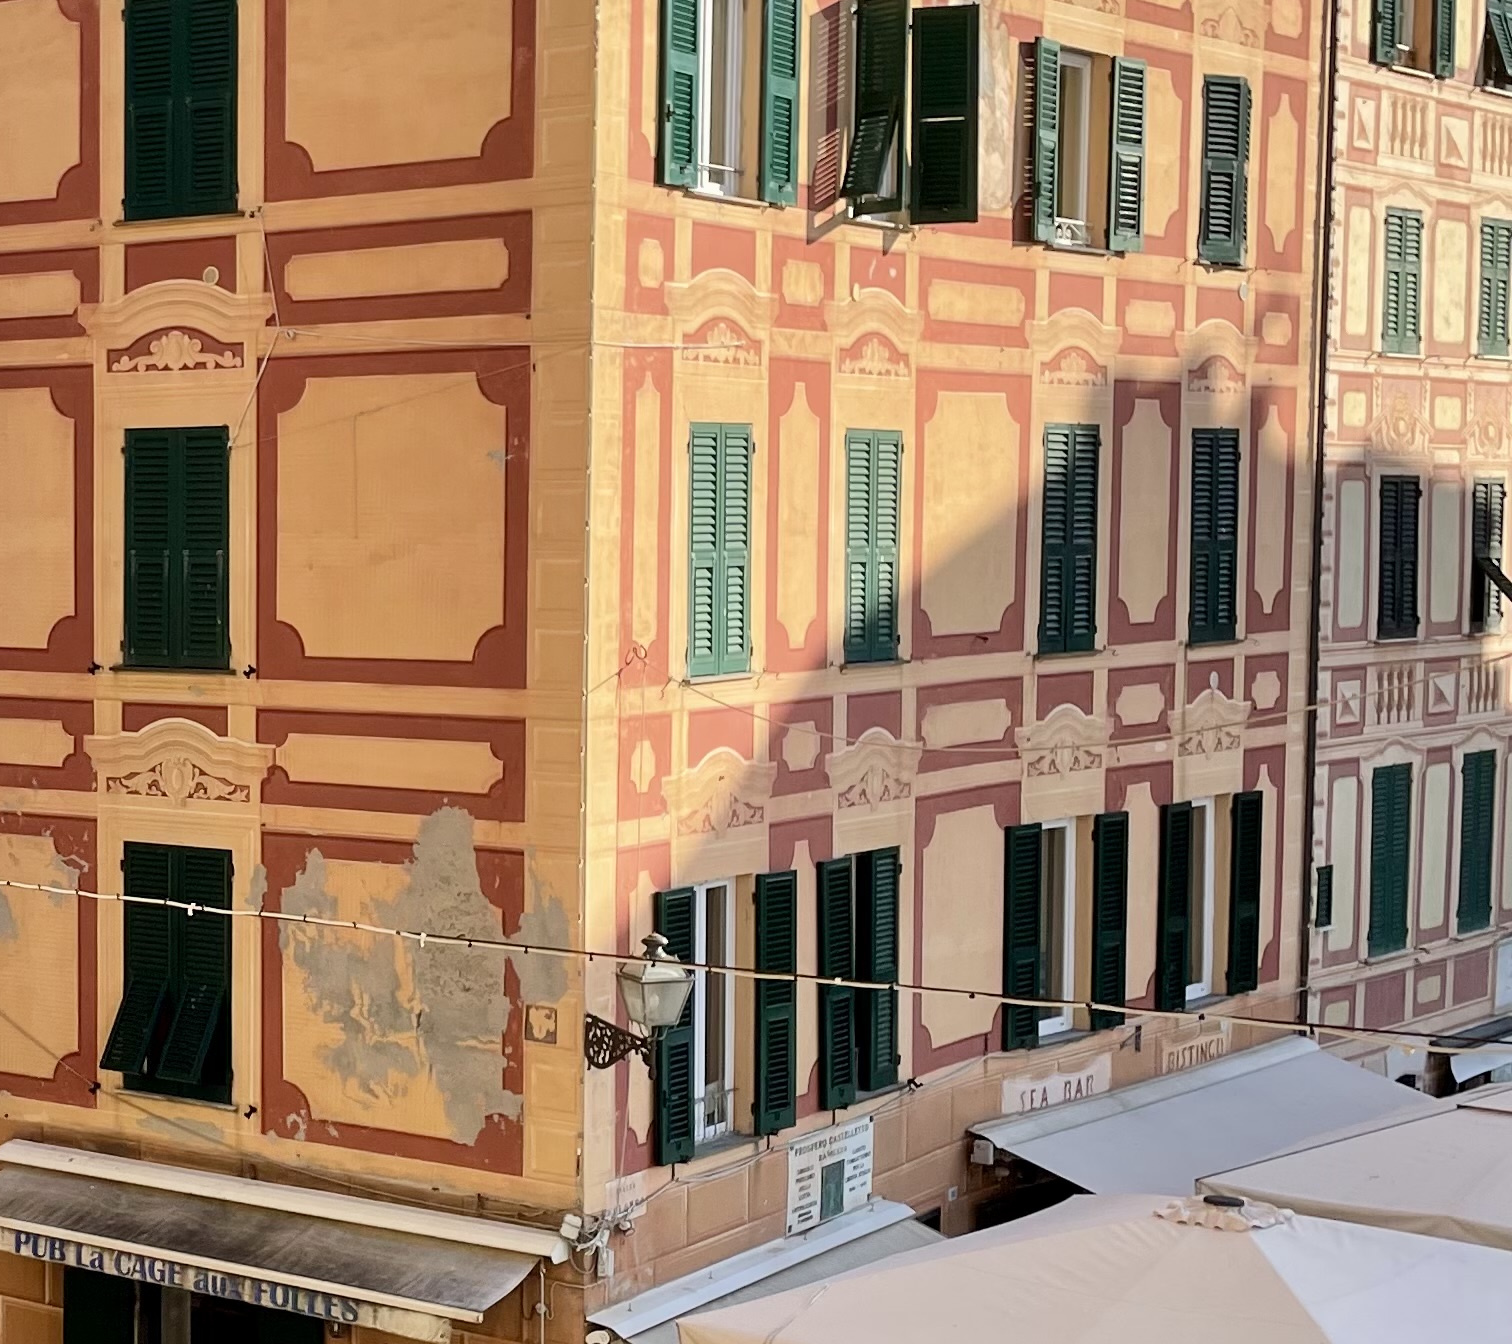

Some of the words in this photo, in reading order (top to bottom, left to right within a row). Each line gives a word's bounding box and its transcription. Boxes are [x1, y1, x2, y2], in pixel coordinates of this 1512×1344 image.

[1020, 1085, 1049, 1113] SEA
[1063, 1074, 1094, 1104] BAR
[14, 1231, 66, 1261] PUB
[75, 1242, 105, 1271] La
[113, 1250, 185, 1286] CAGE
[253, 1281, 359, 1323] FOLLES
